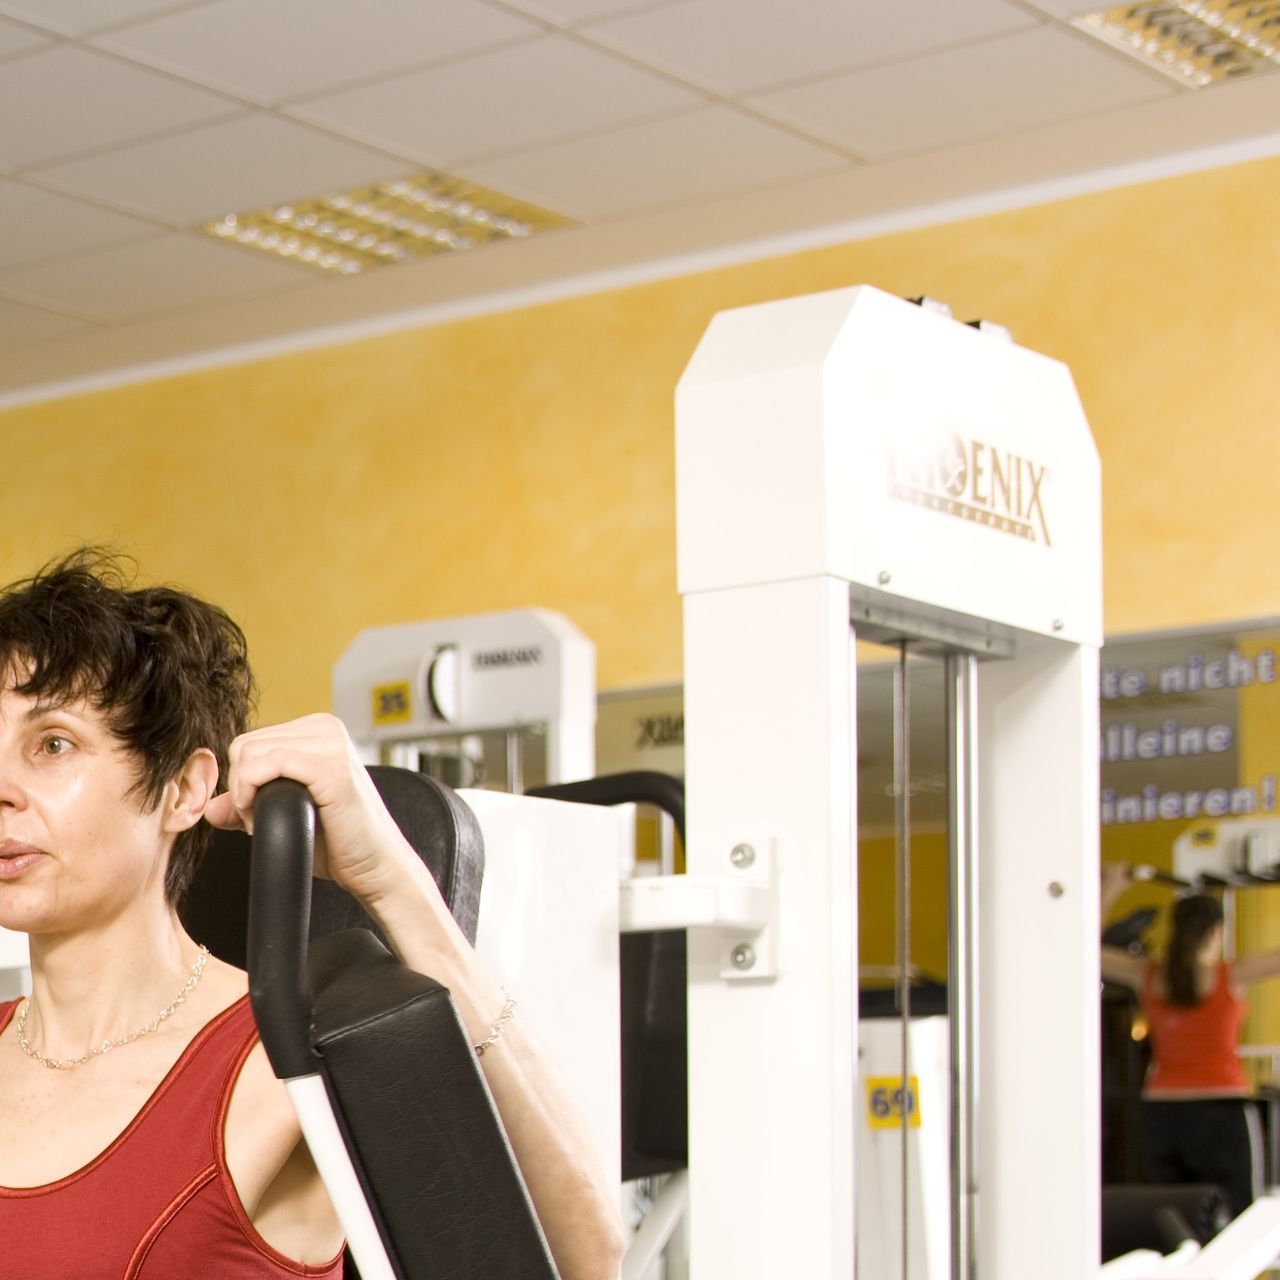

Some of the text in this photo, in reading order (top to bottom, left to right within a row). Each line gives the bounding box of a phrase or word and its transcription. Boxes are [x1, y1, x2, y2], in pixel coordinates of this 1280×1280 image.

[1159, 648, 1276, 693] nicht
[1100, 719, 1232, 761] lleine
[871, 1087, 913, 1119] 69
